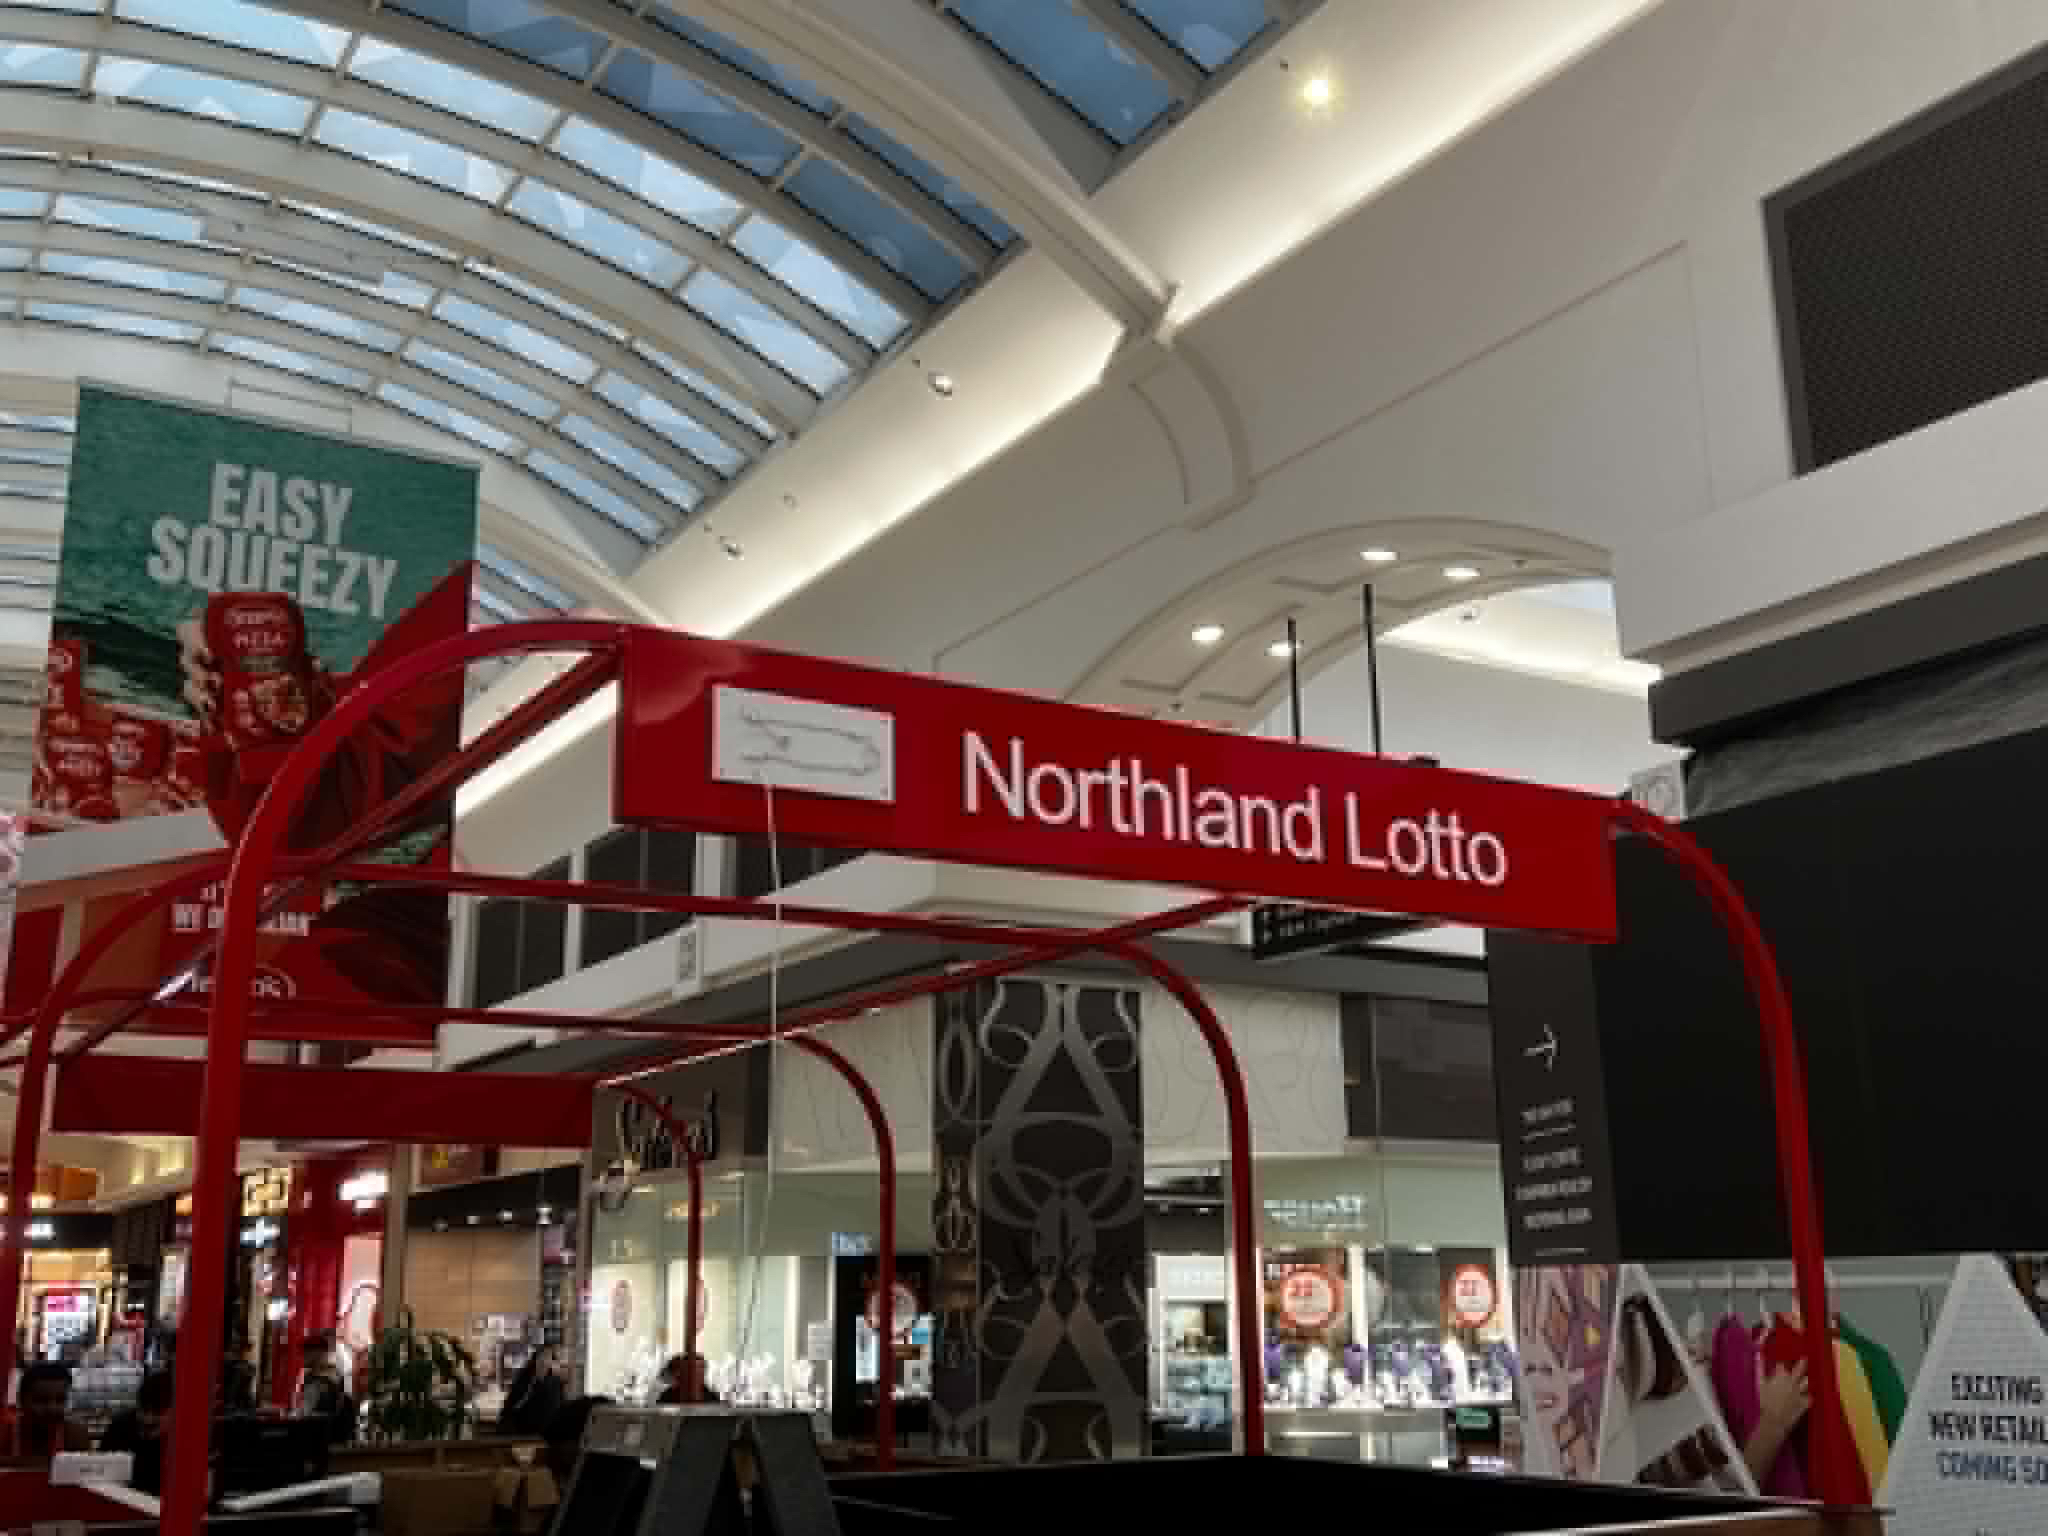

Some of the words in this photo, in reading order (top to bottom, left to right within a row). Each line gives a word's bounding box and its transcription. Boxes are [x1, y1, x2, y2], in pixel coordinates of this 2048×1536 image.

[209, 461, 353, 545] EASY
[146, 514, 399, 619] SQUEEZY
[961, 730, 1323, 863] Northland
[1344, 791, 1508, 888] Lotto
[1951, 1373, 2045, 1407] EXCITING
[1929, 1411, 1977, 1442] NEW
[1936, 1449, 2017, 1485] COMING
